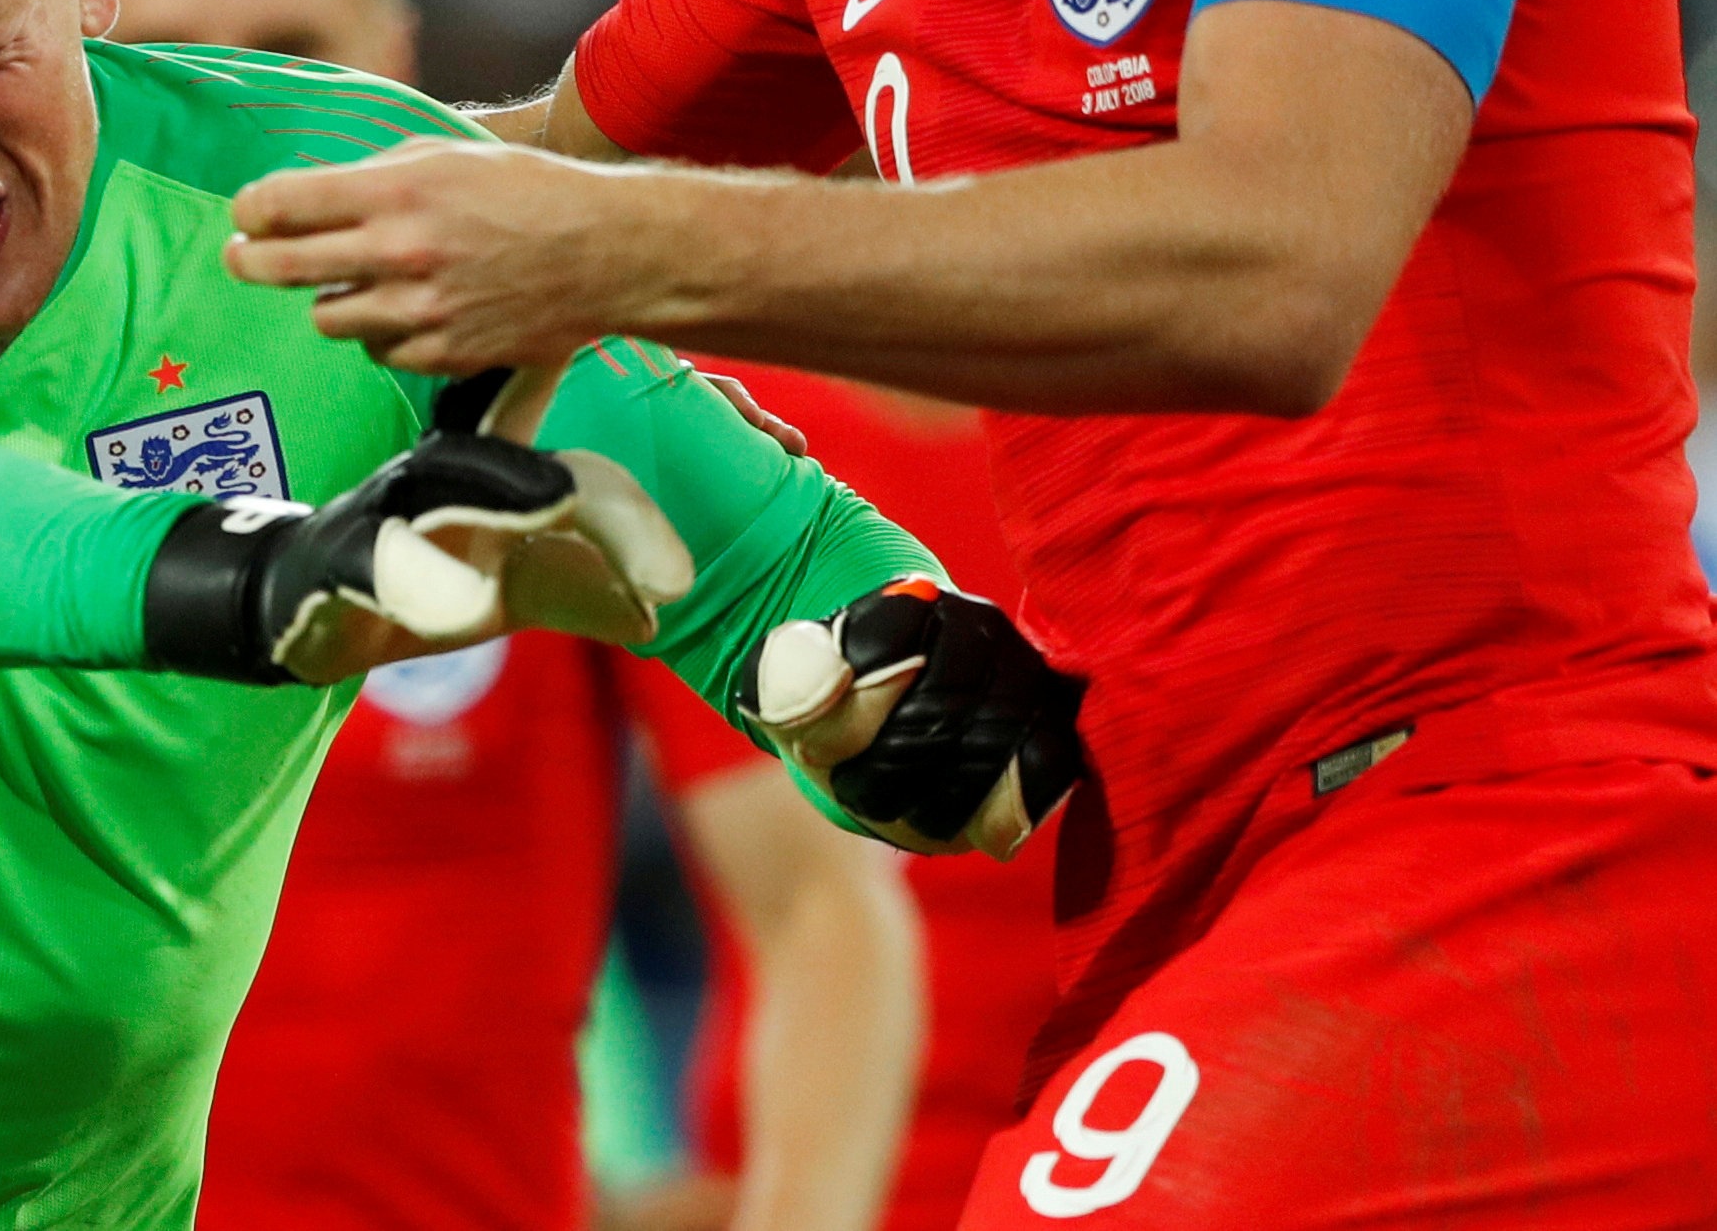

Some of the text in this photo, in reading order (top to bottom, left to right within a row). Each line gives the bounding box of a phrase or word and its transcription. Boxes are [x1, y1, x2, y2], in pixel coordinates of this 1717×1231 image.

[1081, 92, 1093, 115] 3
[1121, 77, 1156, 105] 2018
[1019, 1031, 1200, 1218] 9
